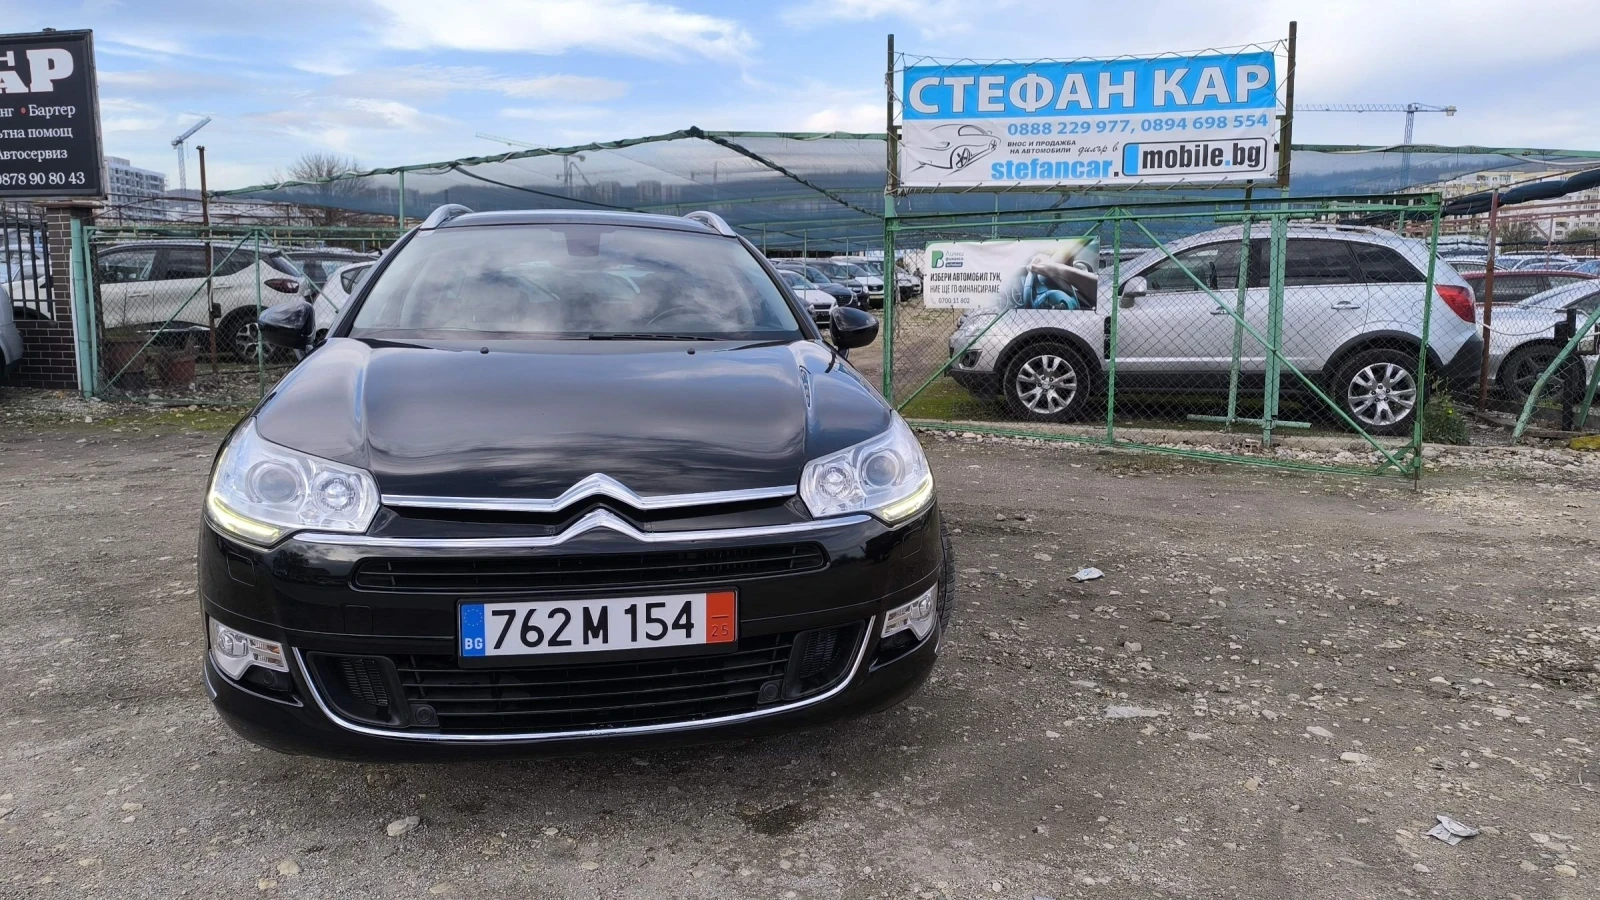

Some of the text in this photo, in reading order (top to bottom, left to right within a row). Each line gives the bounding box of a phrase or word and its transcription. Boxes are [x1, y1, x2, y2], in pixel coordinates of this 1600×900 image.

[908, 64, 1271, 114] СТЕФАН КАР
[28, 104, 76, 119] Бартер
[1007, 114, 1269, 136] 0888 229 977, 0894 698 554
[28, 127, 74, 138] помощ
[1035, 139, 1077, 148] ПРОДАЖБА
[1142, 142, 1261, 169] mobile.bg
[0, 171, 86, 185] 878 90 80 43
[930, 272, 1002, 282] ИЗБЕРИ АВТОМОБИЛ ТУК,
[930, 284, 1000, 294] НИЕ ЩЕ ГО ФИНАНСИРАМЕ
[491, 600, 695, 650] 762 M 154
[711, 624, 729, 637] 25
[464, 637, 484, 650] BG
